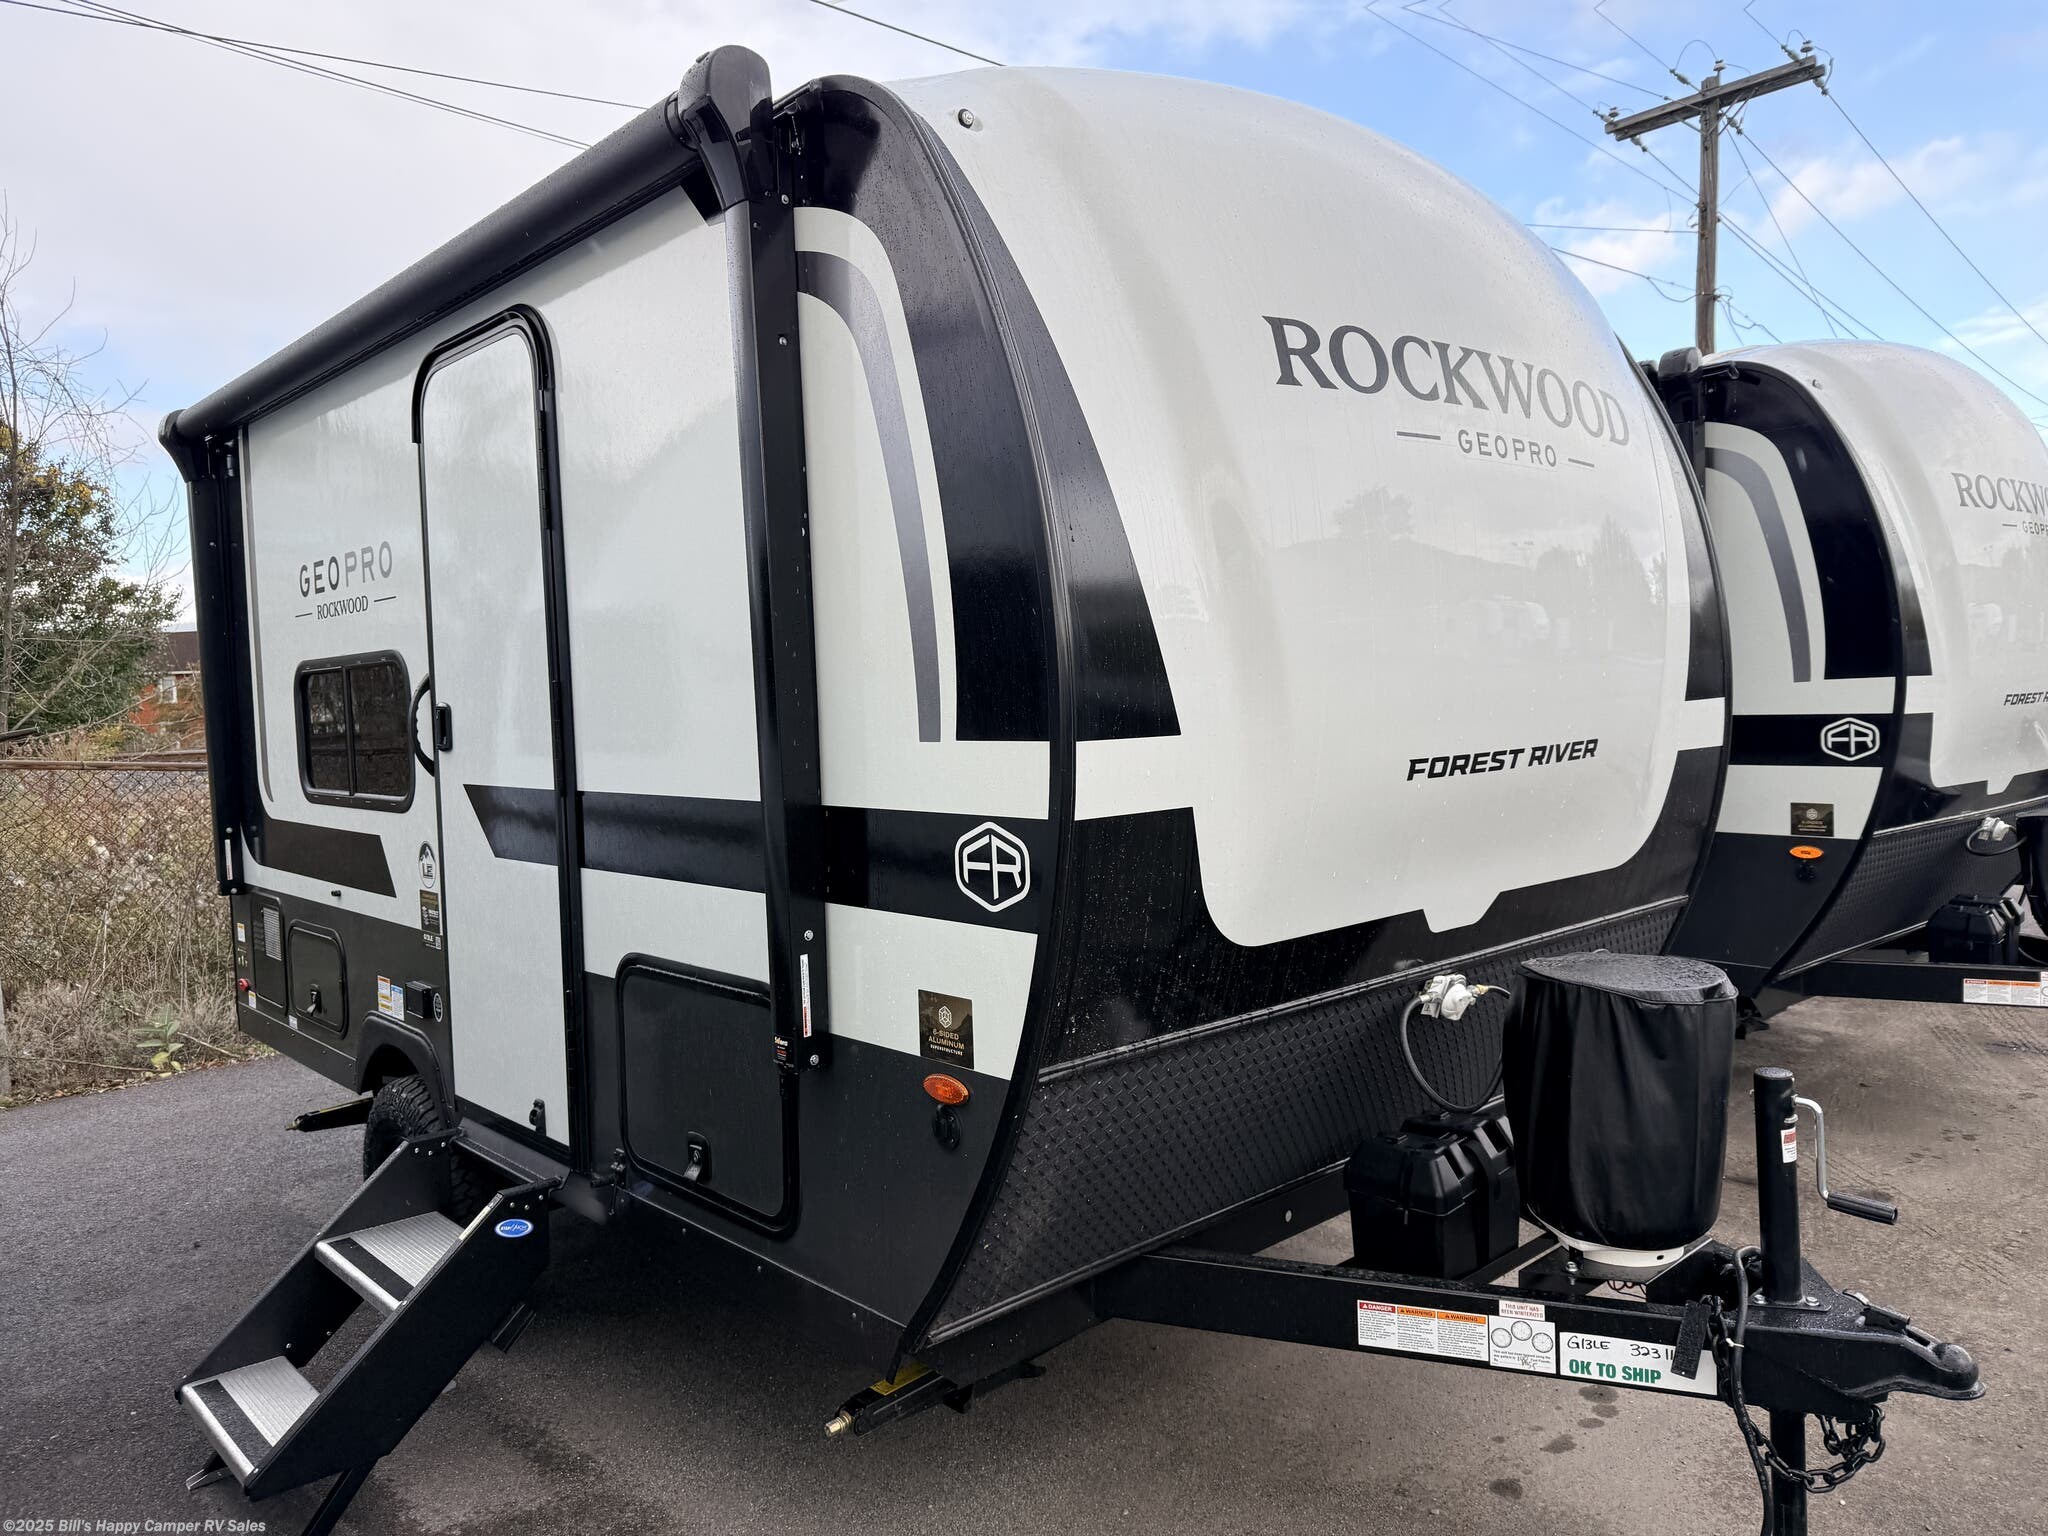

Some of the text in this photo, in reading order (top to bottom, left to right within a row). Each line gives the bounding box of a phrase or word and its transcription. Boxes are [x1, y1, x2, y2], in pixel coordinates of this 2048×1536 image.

[1262, 315, 1630, 447] ROCKWOOD
[1457, 428, 1557, 468] GEOPRO
[1951, 472, 2048, 516] ROCKW
[299, 540, 393, 598] GEOPRO
[317, 595, 368, 620] ROCKWOOD
[2003, 691, 2044, 706] FOREST
[1406, 738, 1599, 781] FOREST RIVER
[928, 1035, 965, 1050] ALUMINUM
[1368, 1304, 1392, 1313] DANGER
[1405, 1308, 1434, 1318] WARNING
[1451, 1314, 1478, 1323] WARNING
[1569, 1358, 1592, 1376] OK
[1596, 1362, 1617, 1379] TO
[1621, 1366, 1662, 1384] SHIP
